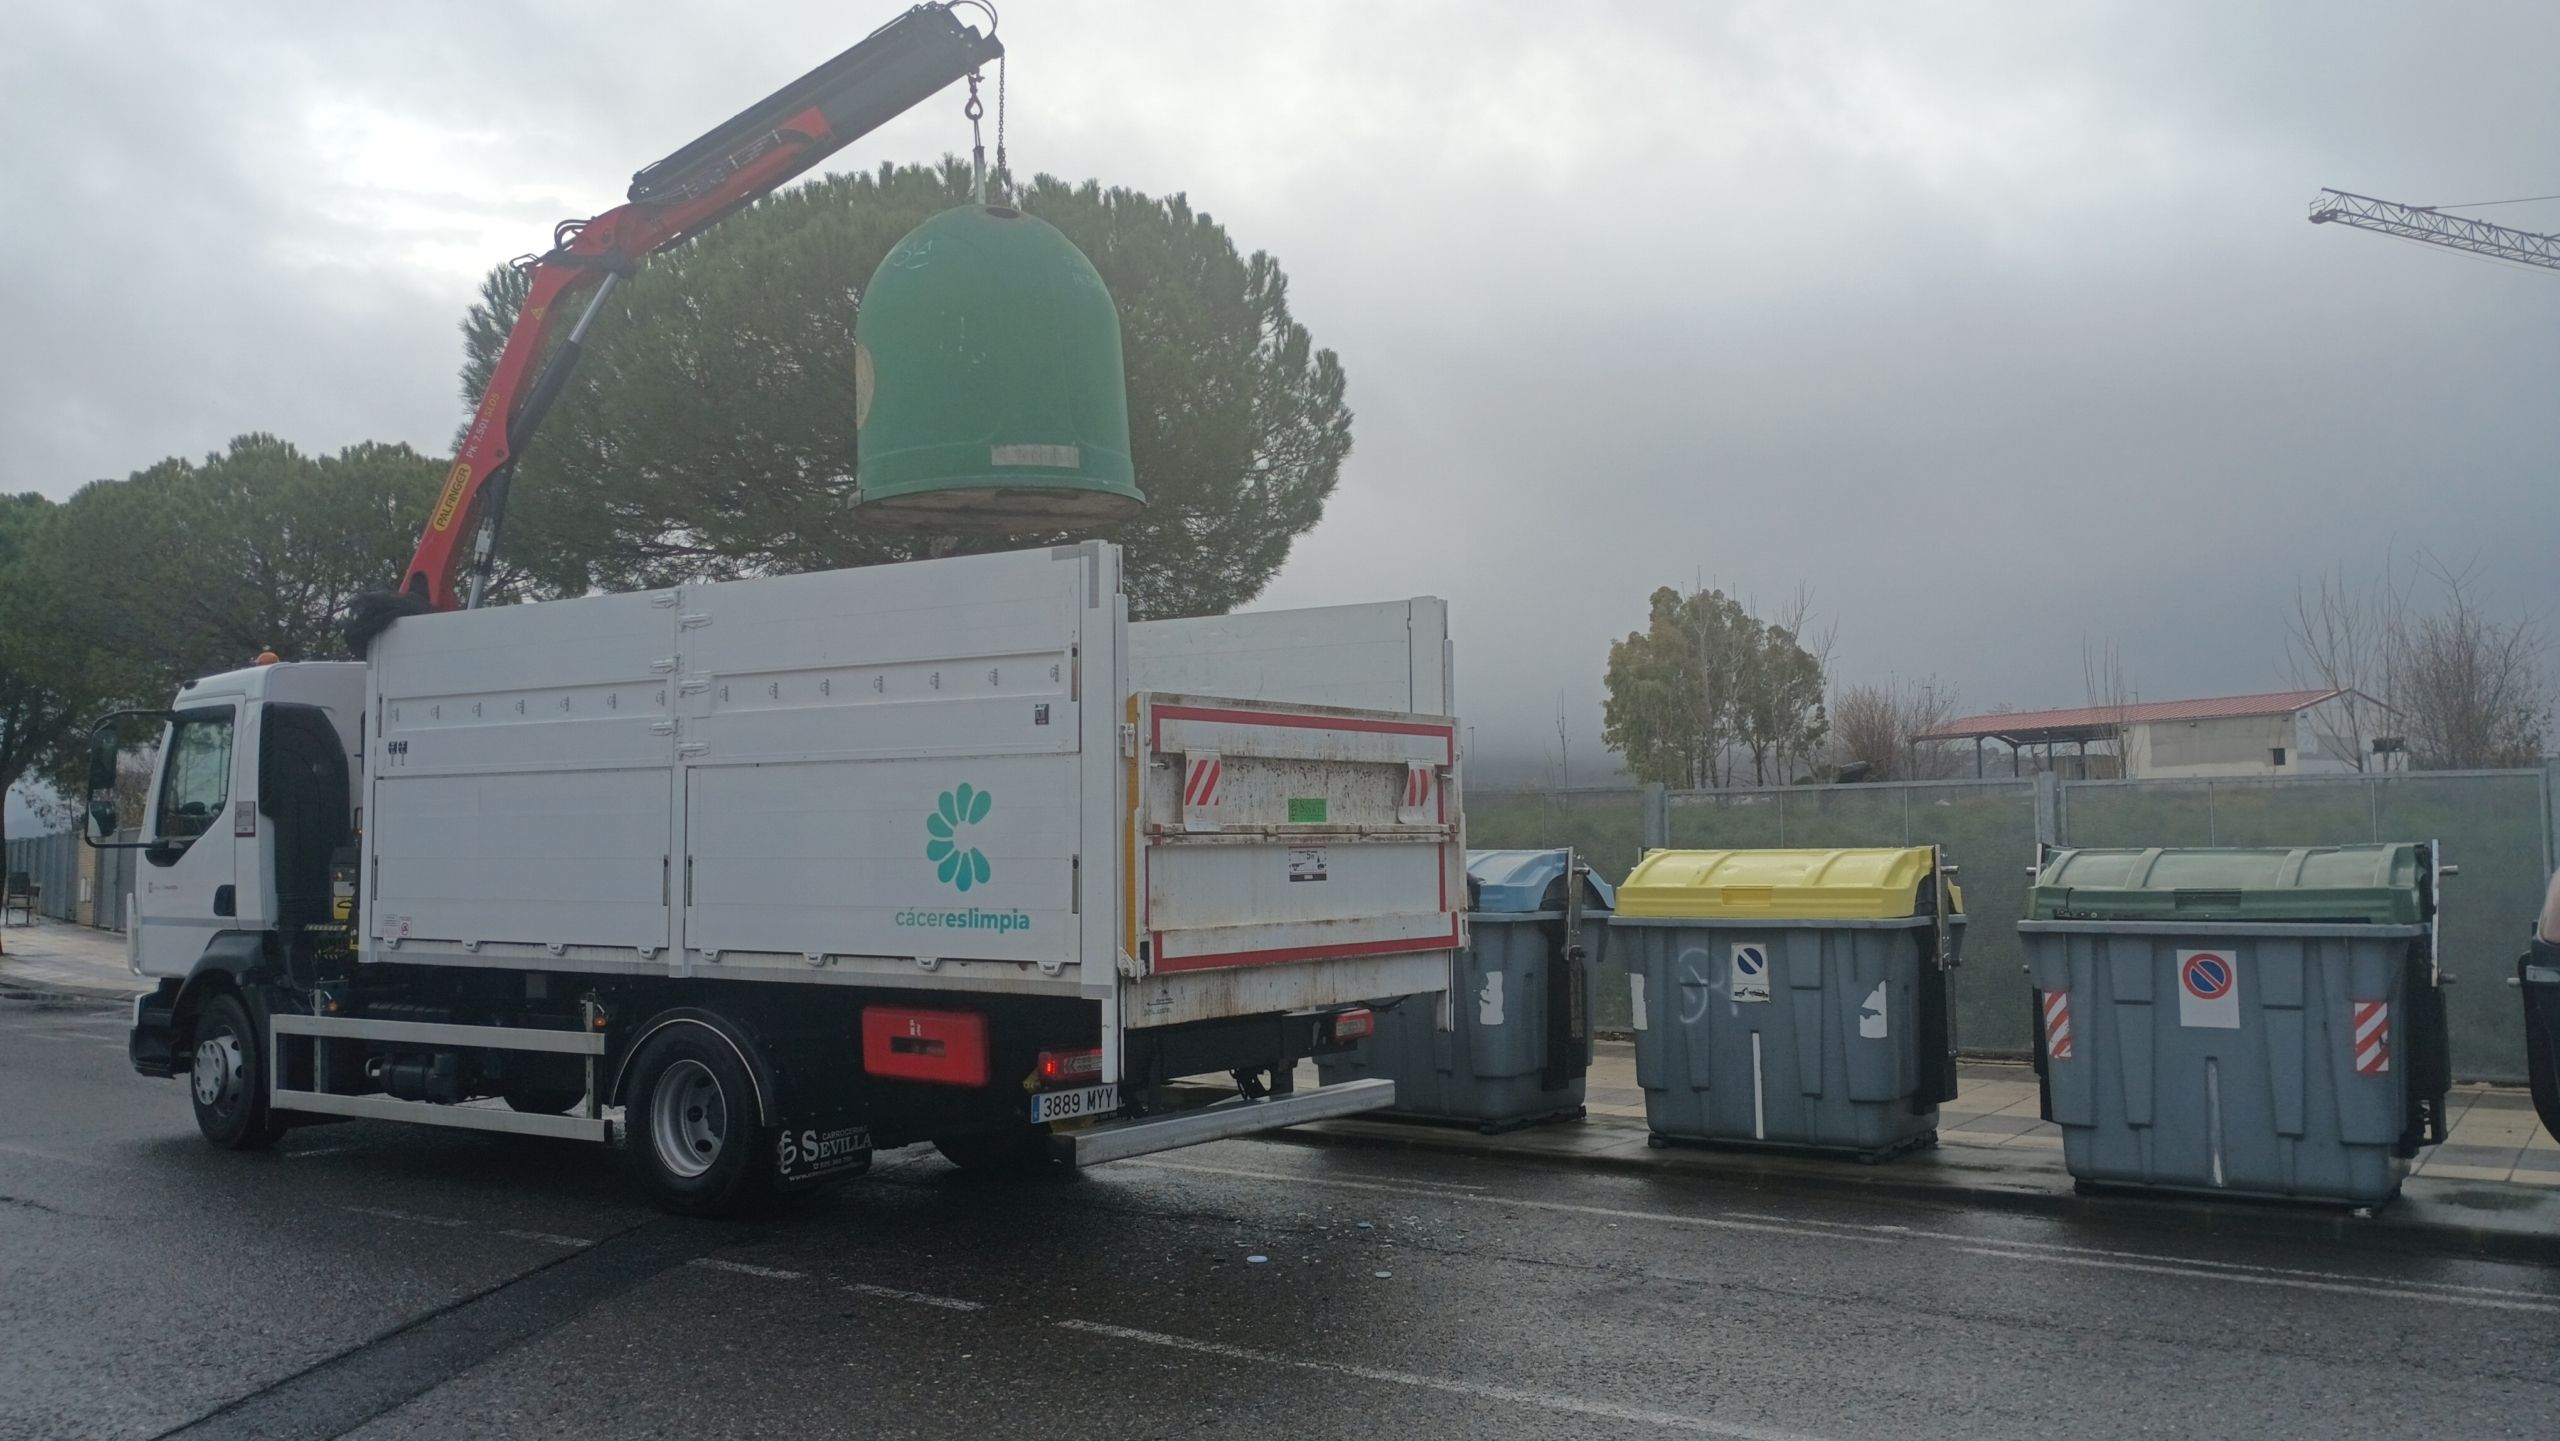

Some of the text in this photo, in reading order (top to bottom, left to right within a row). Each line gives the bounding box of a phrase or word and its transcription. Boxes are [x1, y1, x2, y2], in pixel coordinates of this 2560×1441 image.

[436, 467, 469, 528] PALFINGER
[895, 907, 1030, 934] cácereslimpia
[1044, 1088, 1113, 1118] 3889 MYY
[801, 1128, 873, 1163] SEVILLA
